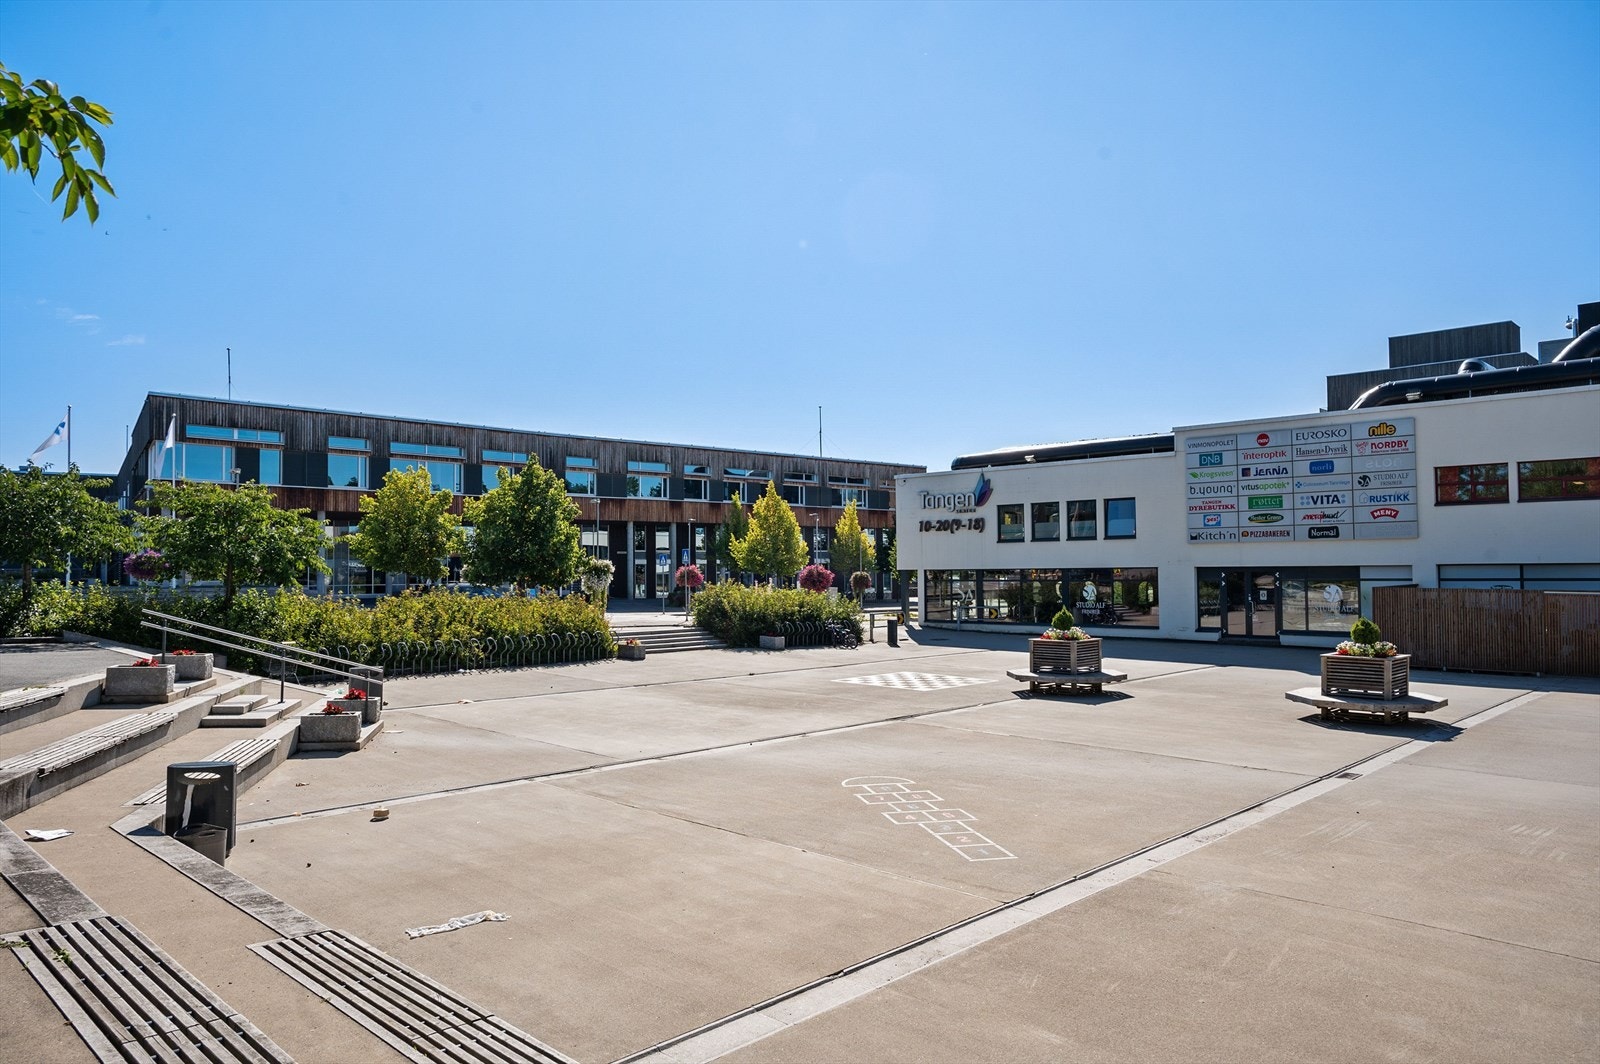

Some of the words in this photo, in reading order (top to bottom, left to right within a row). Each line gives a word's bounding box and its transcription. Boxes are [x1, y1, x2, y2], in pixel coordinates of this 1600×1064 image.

[1370, 423, 1396, 436] nille
[1296, 429, 1347, 441] EUROSKO
[1187, 439, 1234, 449] VINMONOPOLET
[1201, 455, 1221, 465] DNB
[1243, 450, 1287, 461] interoptik
[1312, 463, 1332, 472] norli
[1199, 471, 1233, 479] Krogsveen
[919, 490, 976, 512] Tangen
[1310, 494, 1341, 505] VITA
[1369, 493, 1409, 503] RUSTIKK
[1373, 509, 1396, 518] MENY
[919, 518, 985, 534] 10-20(9-18)
[1250, 530, 1290, 538] PIZZABAKEREN
[1311, 528, 1336, 537] Normal
